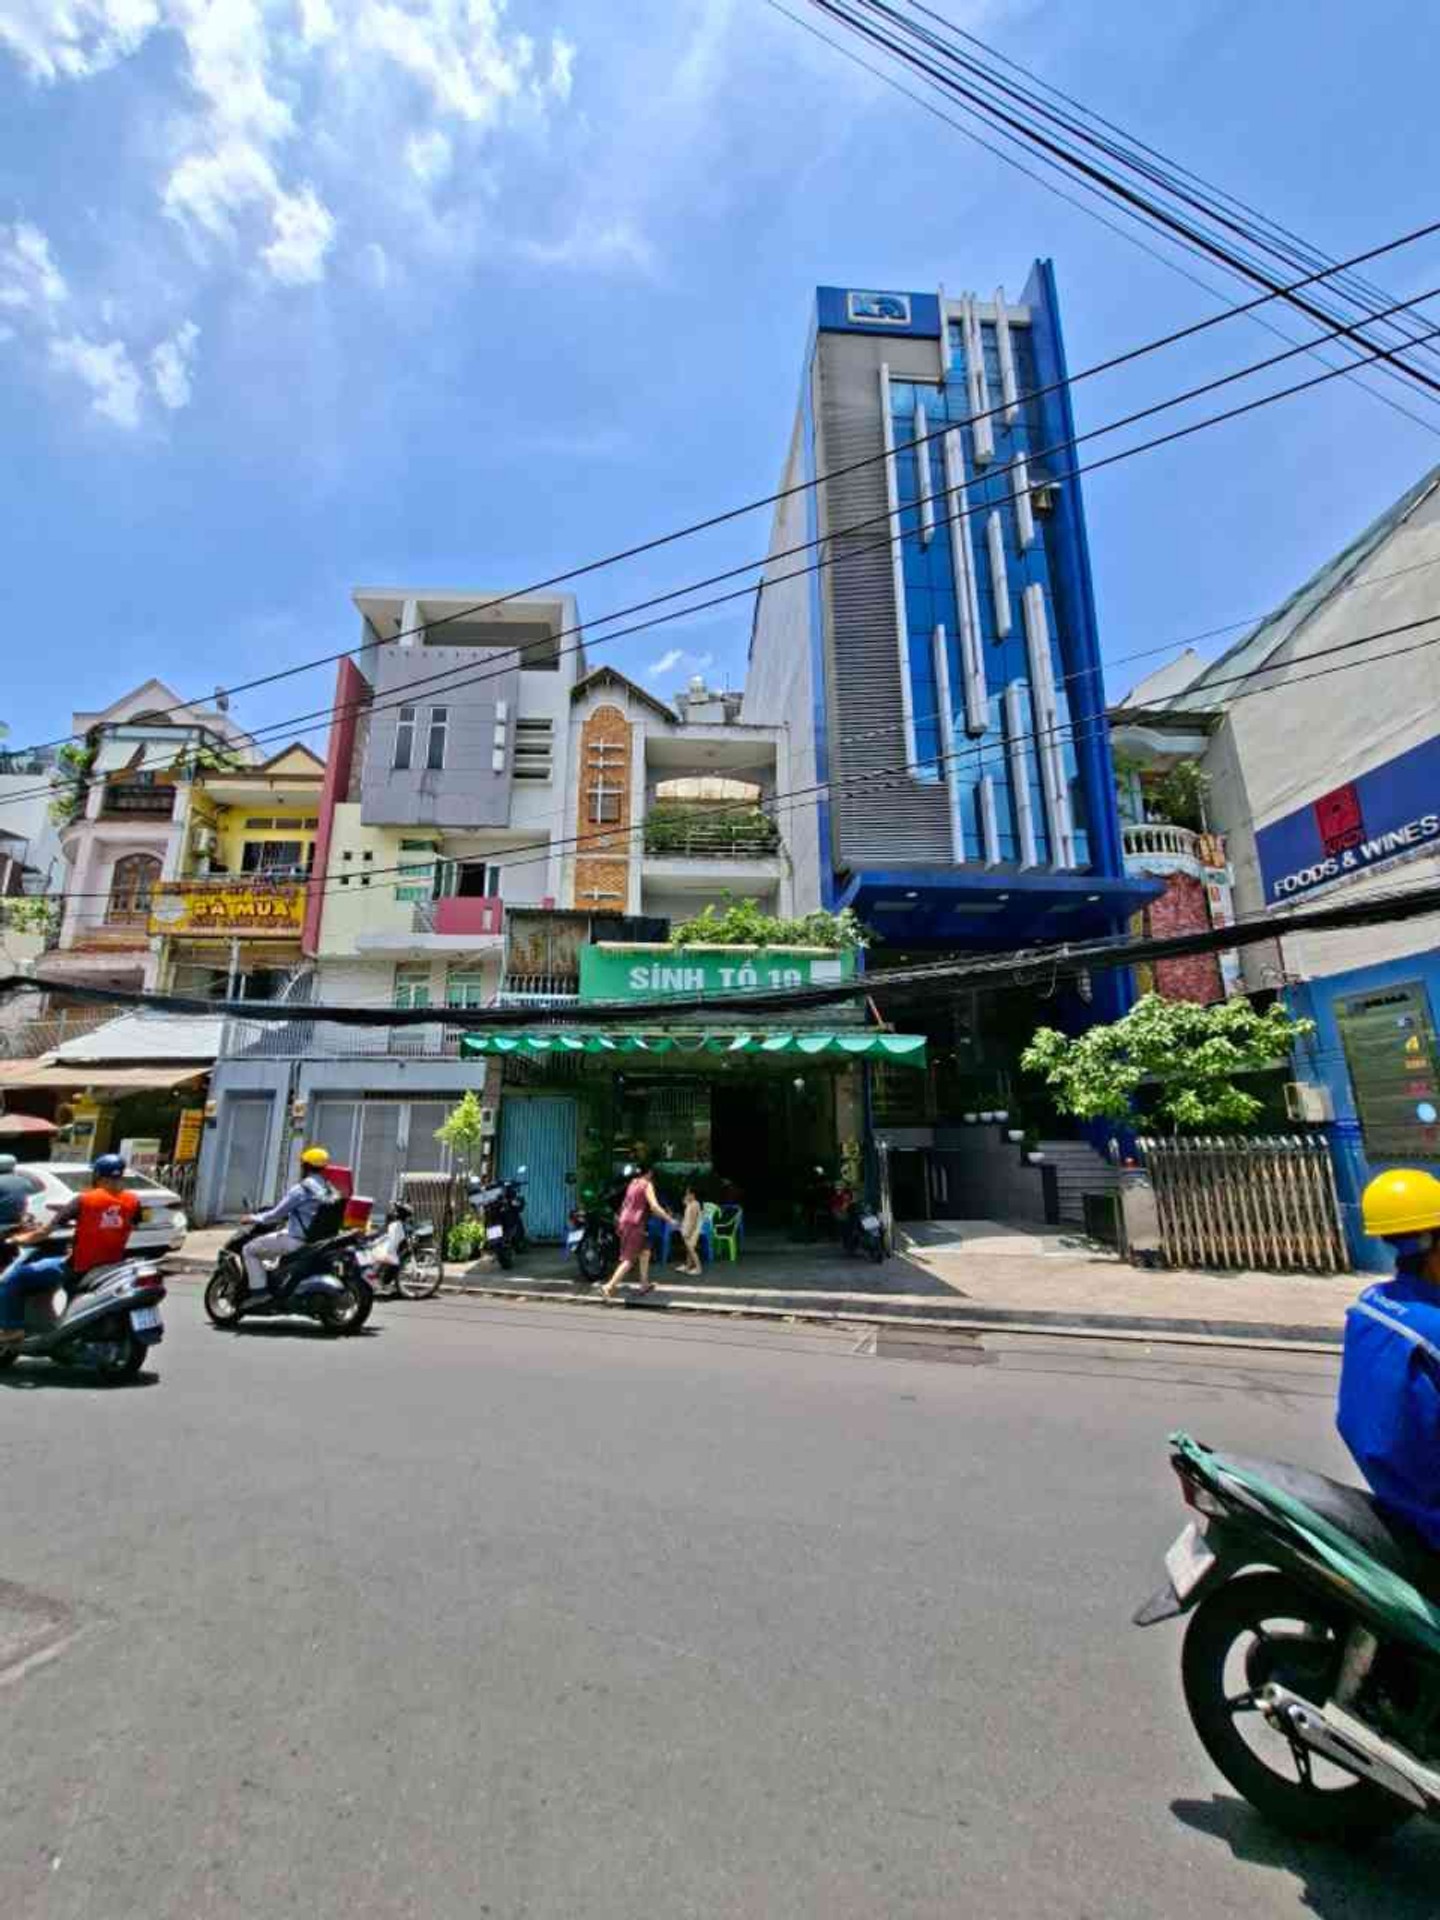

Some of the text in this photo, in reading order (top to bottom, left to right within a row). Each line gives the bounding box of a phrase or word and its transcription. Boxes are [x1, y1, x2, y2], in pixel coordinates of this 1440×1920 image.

[1273, 858, 1339, 896] FOODS
[1342, 849, 1357, 868] &
[1360, 815, 1440, 859] WINES
